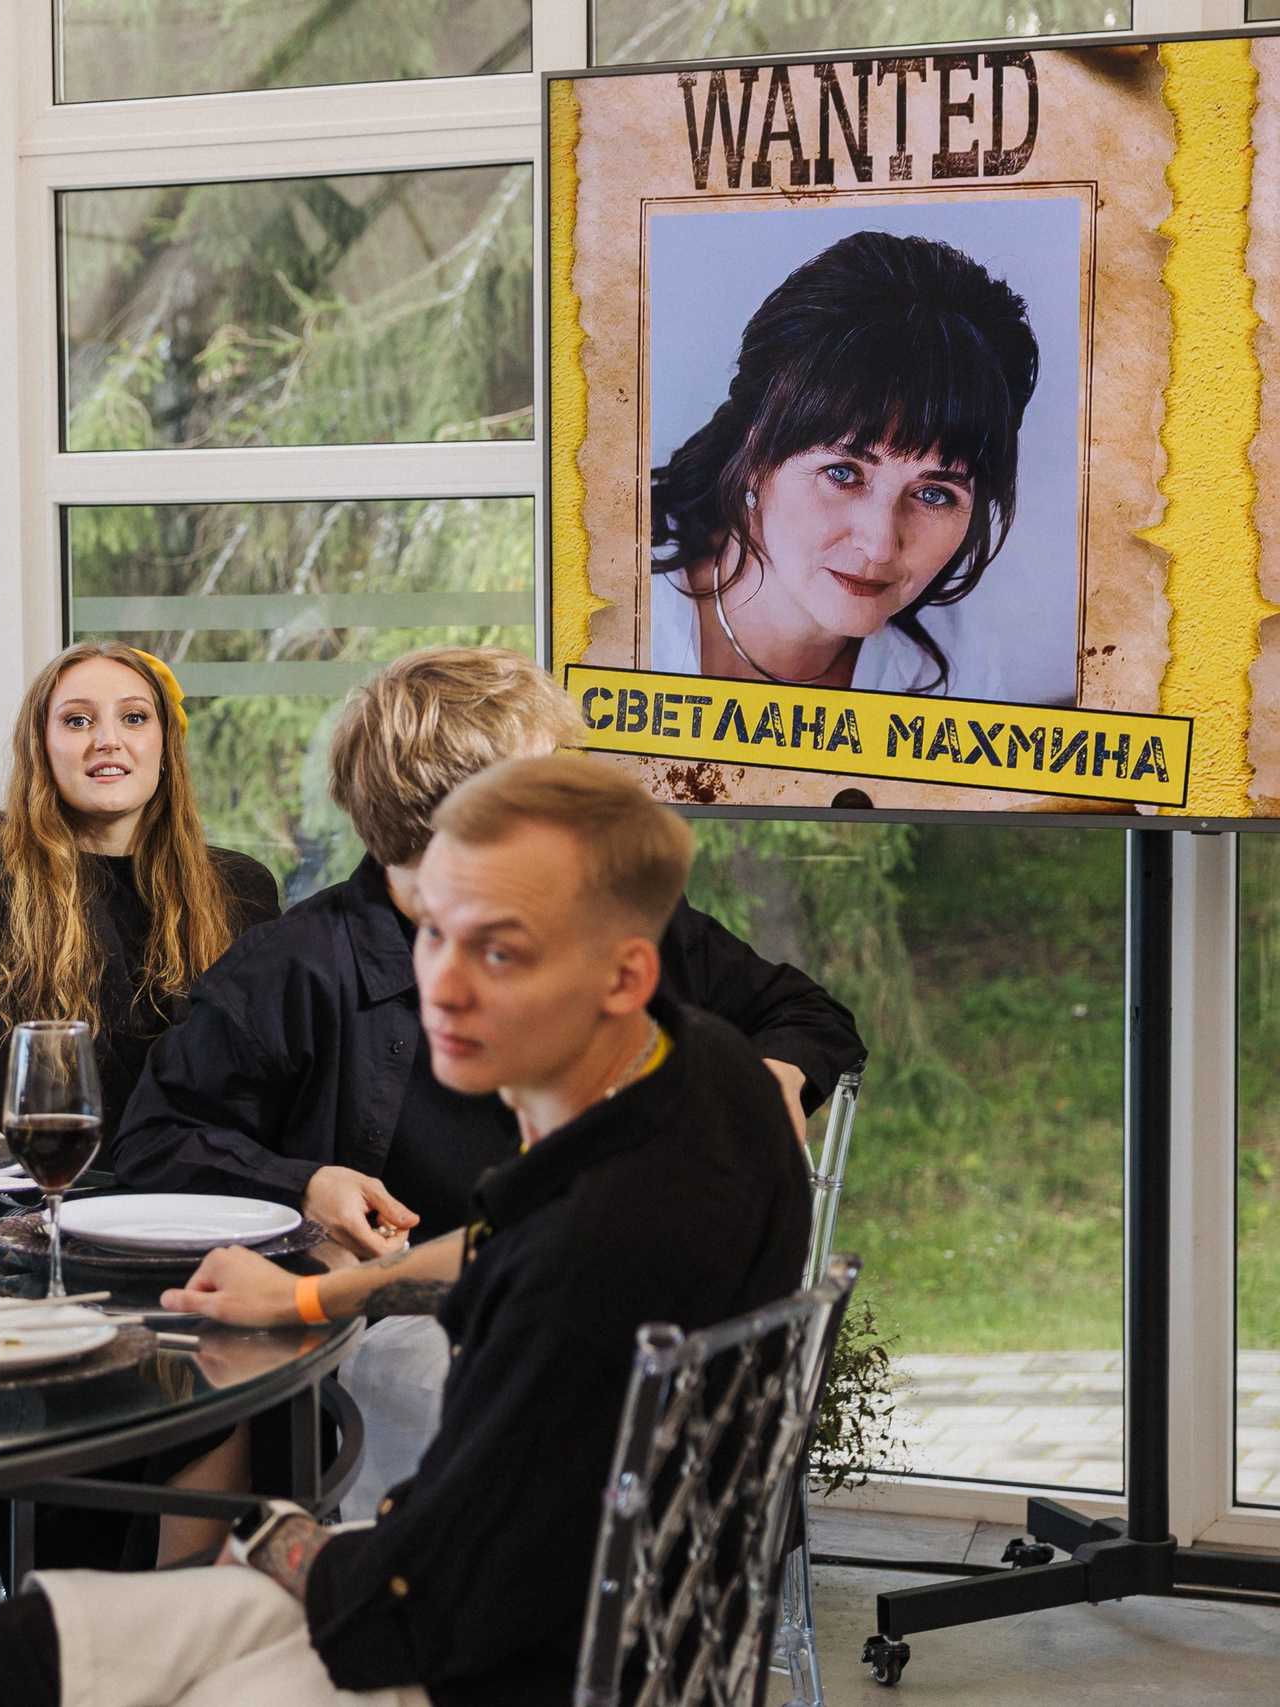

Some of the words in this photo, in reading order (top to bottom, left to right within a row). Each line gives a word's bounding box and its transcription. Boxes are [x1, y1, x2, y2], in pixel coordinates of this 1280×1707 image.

[677, 53, 1039, 189] WANTED
[581, 687, 863, 755] СВЕТЛАНА
[887, 714, 1170, 783] МАХМИНА
